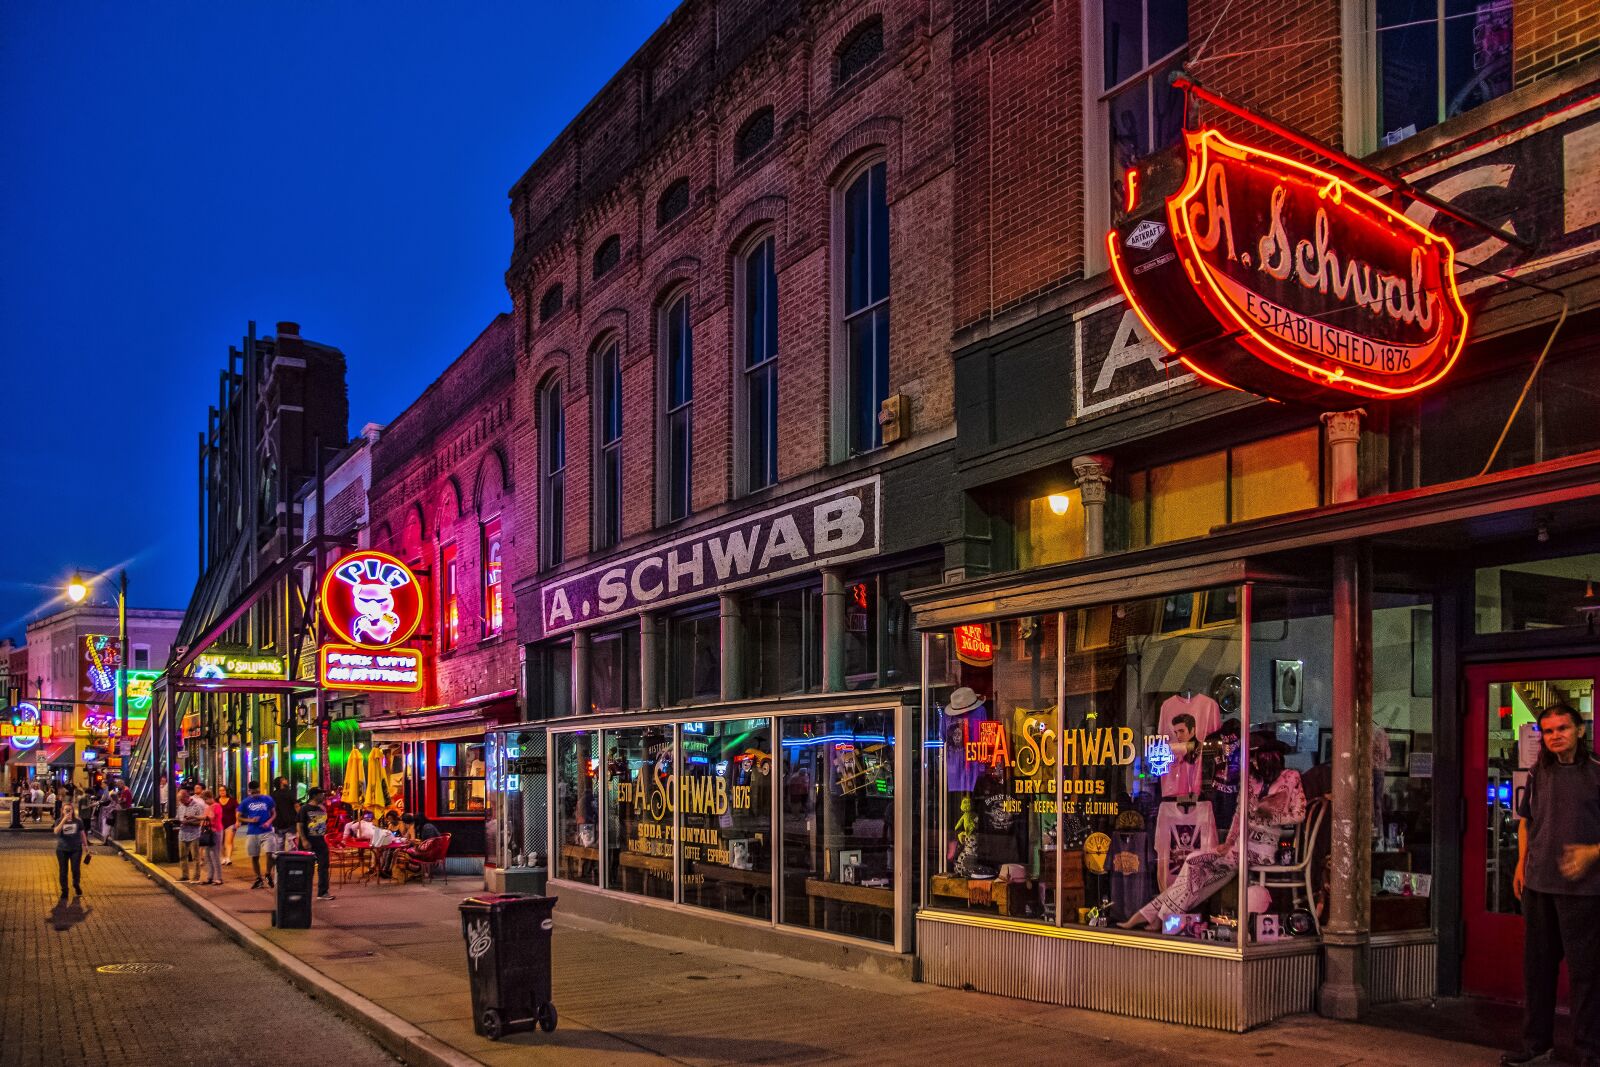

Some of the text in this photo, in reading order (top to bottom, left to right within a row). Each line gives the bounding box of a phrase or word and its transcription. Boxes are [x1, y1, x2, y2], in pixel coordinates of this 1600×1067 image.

[1131, 225, 1161, 246] ARTKRAFT
[1246, 292, 1412, 373] ESTABLISHED 1876
[598, 496, 865, 613] SCHWAB
[335, 559, 411, 589] PIG
[1016, 716, 1136, 776] SCHWAB
[650, 758, 728, 820] SCHWAB
[732, 785, 750, 809] 1876
[1015, 780, 1105, 795] DRY GOODS
[1003, 800, 1022, 813] MUSIC
[1085, 802, 1119, 816] CLOTHING
[637, 823, 662, 839] SODA
